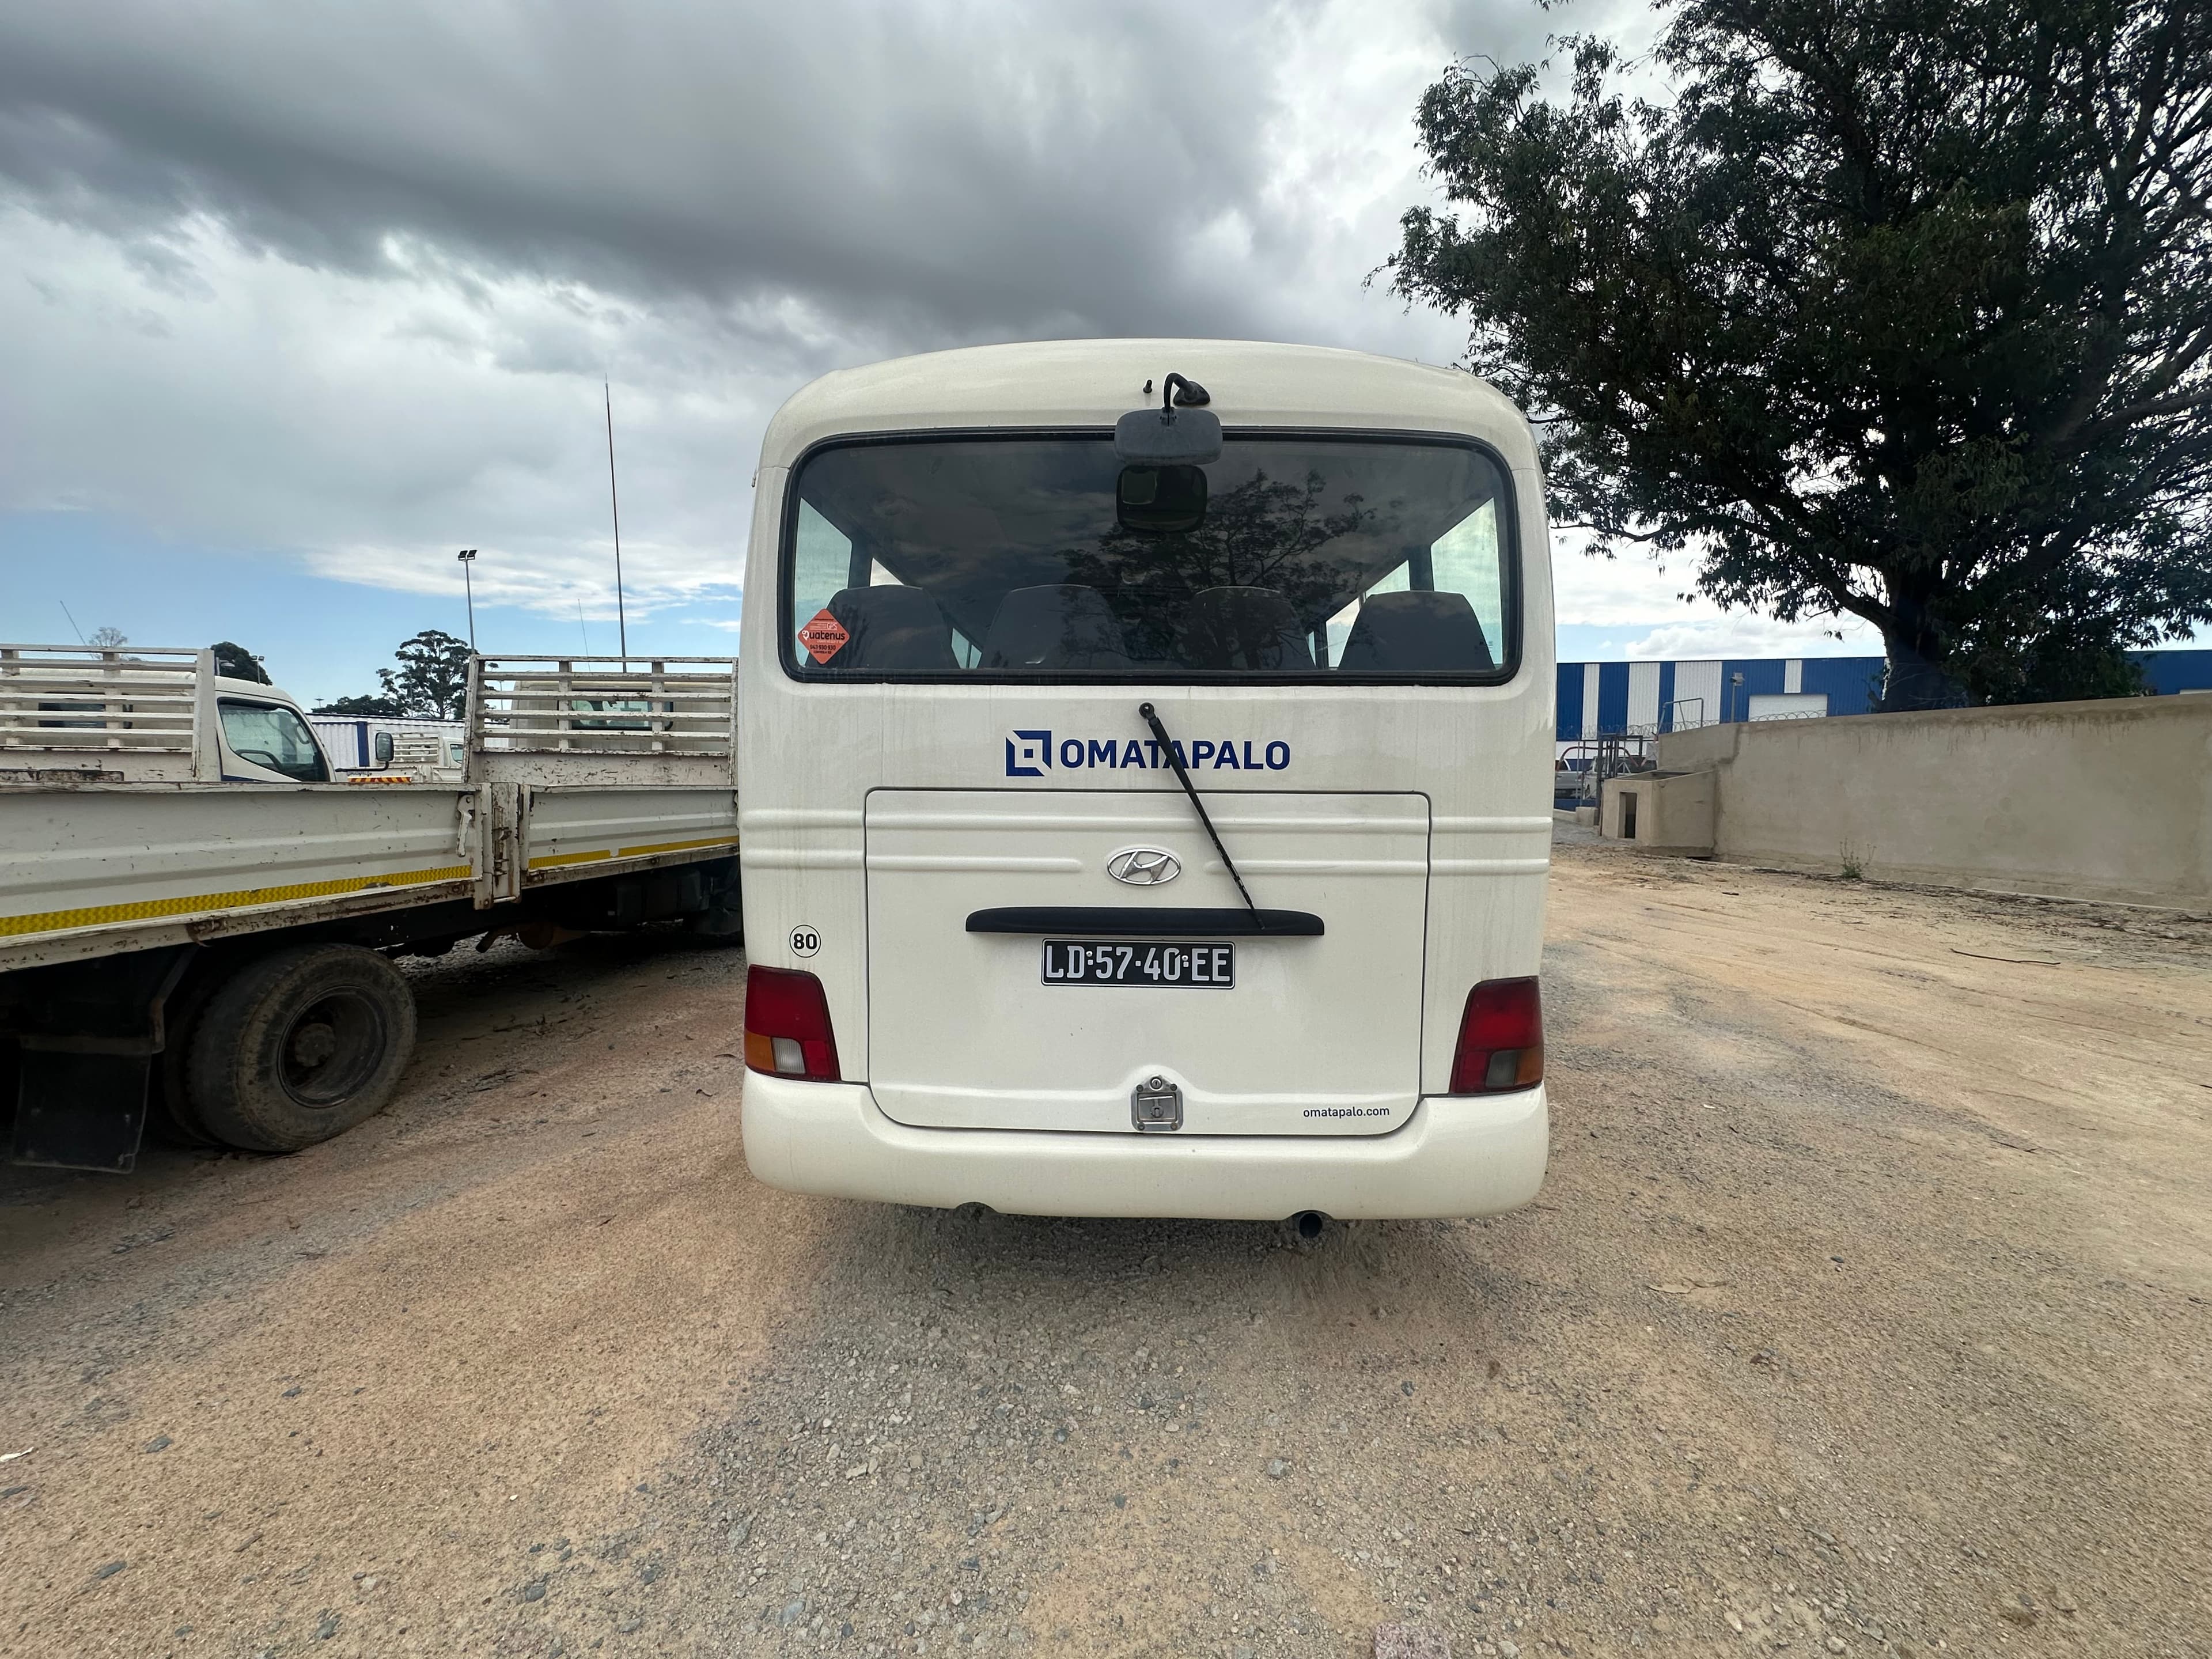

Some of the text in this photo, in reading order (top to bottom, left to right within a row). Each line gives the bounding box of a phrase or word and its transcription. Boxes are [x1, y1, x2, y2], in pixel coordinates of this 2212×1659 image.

[1060, 739, 1290, 770] OMATAPALO
[794, 933, 817, 949] 80
[1303, 1106, 1390, 1119] omatapalo.com
